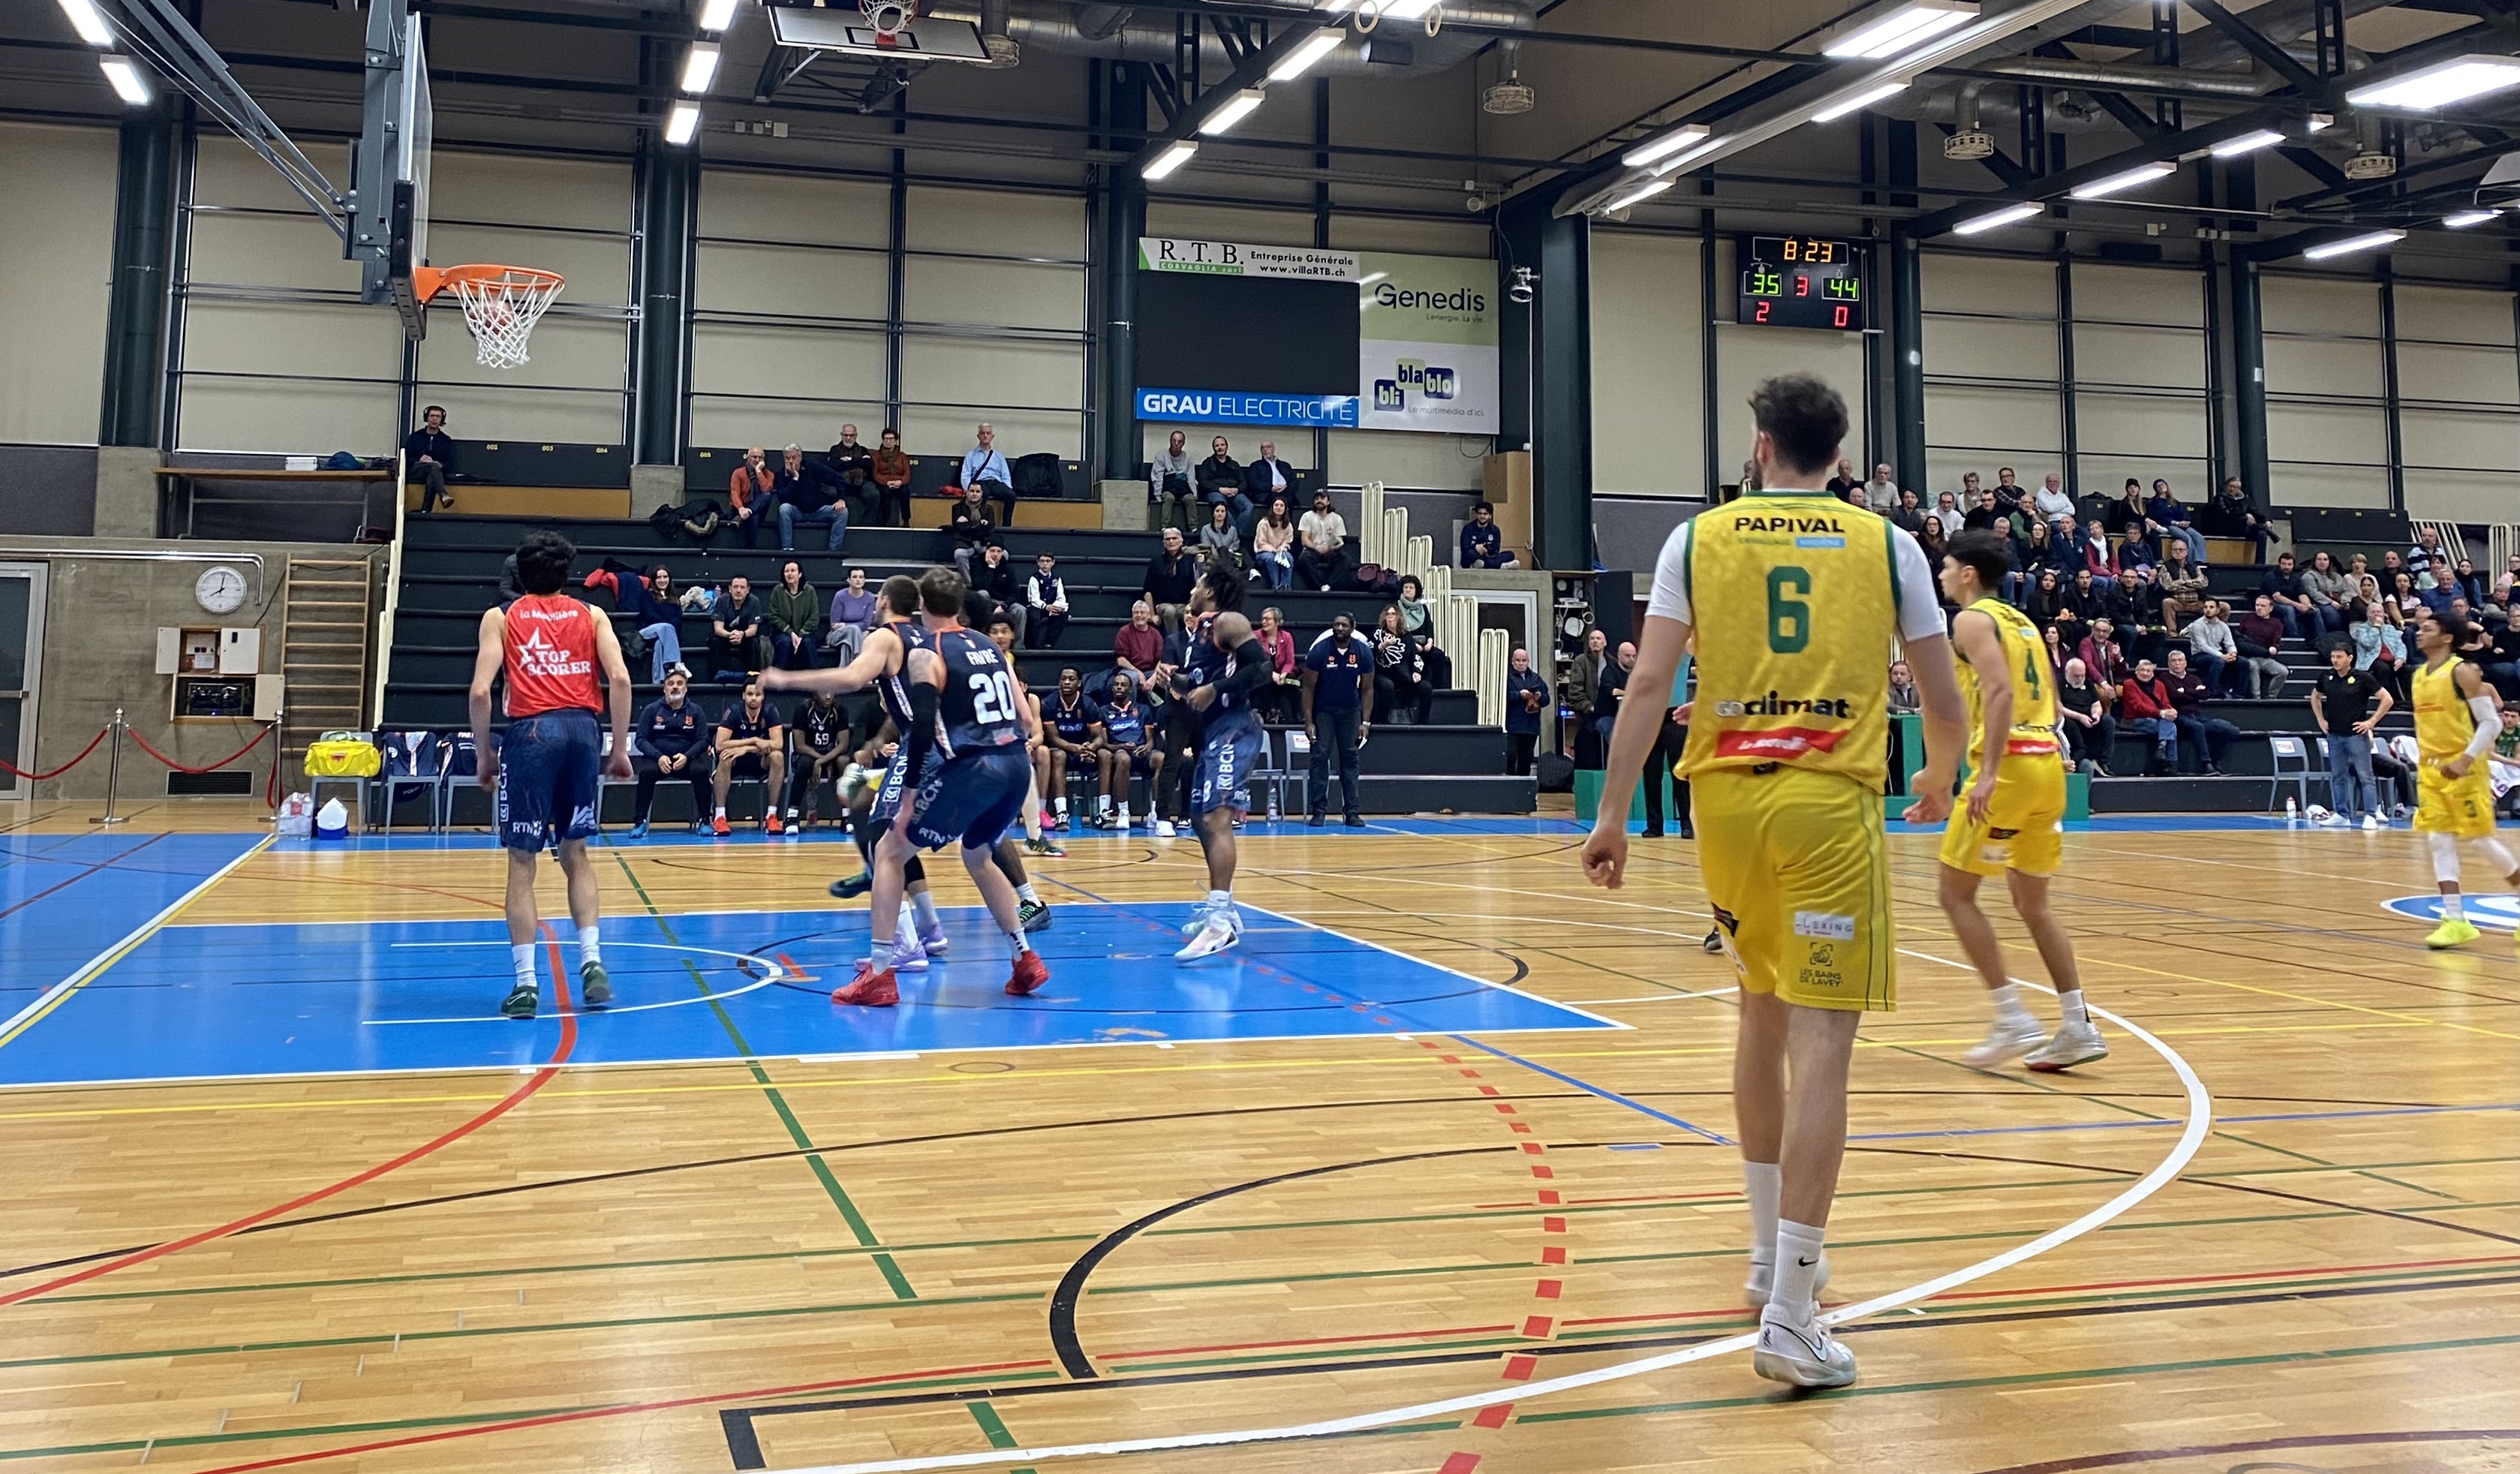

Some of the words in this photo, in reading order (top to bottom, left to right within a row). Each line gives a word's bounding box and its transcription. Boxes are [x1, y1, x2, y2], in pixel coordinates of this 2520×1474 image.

[1250, 251, 1303, 263] Entreprise
[1306, 254, 1354, 266] Générale
[1783, 240, 1833, 263] 8:23
[1161, 263, 1217, 272] CORVAGLIA
[1260, 265, 1346, 277] www.villaRTB.ch
[1752, 272, 1780, 295] 35
[1795, 275, 1809, 297] 3
[1830, 278, 1857, 299] 44
[1374, 282, 1485, 312] Genedis
[1755, 301, 1770, 323] 2
[1834, 305, 1848, 327] 0
[1398, 364, 1424, 384] bla
[1426, 373, 1453, 395] blo
[1143, 393, 1212, 415] GRAU
[1379, 385, 1400, 406] bli
[1408, 405, 1417, 414] Le
[1734, 516, 1846, 533] PAPIVAL
[520, 609, 531, 619] la
[1767, 566, 1812, 654] 6
[535, 649, 571, 663] TOP
[965, 648, 1000, 666] FAVRE
[527, 660, 591, 676] SCORER
[2024, 648, 2040, 700] 4
[969, 670, 1017, 724] 20
[814, 732, 829, 745] 69
[1219, 744, 1234, 773] BCN
[889, 755, 908, 785] BCN
[2464, 799, 2477, 818] 3
[513, 822, 534, 835] RTN
[1800, 968, 1813, 977] LES
